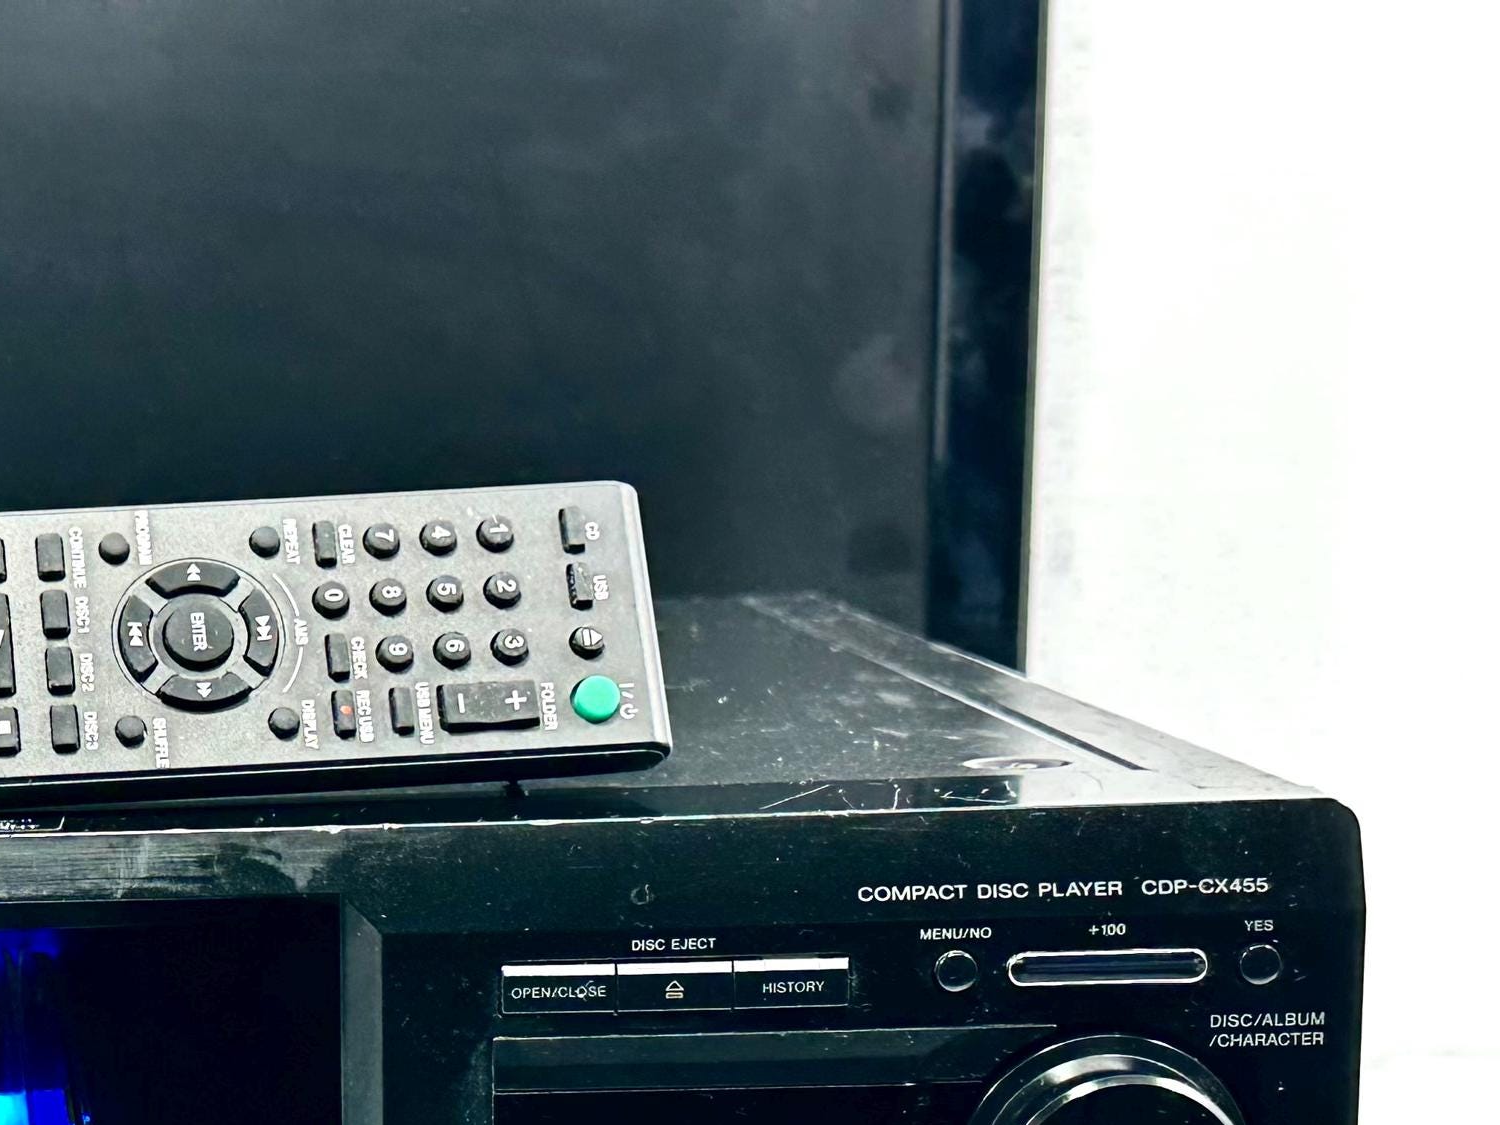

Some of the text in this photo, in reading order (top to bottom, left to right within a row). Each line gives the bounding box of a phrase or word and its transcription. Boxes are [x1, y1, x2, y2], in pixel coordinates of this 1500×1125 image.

[375, 529, 395, 542] 7
[431, 526, 451, 540] 4
[489, 523, 509, 533] 1
[584, 522, 600, 540] CD
[282, 518, 301, 564] REPEAT
[338, 524, 356, 565] CLEAR
[68, 526, 88, 588] CONTINUE
[382, 585, 402, 599] 8
[437, 582, 456, 596] 5
[497, 579, 517, 593] 2
[592, 574, 610, 601] USB
[190, 612, 208, 651] ENTER
[389, 642, 408, 656] 9
[445, 639, 465, 653] 6
[504, 635, 525, 649] 3
[350, 637, 369, 680] CHECK
[540, 682, 559, 730] FOLDER
[301, 699, 319, 749] DISPLAY
[417, 708, 435, 745] MENU
[152, 717, 170, 768] SHUFFLE
[857, 877, 1270, 902] COMPACT DISC PLAYER CDP-CX455
[1087, 922, 1127, 937] +100
[1244, 918, 1274, 933] YES
[919, 926, 993, 942] MENU/NO
[631, 937, 717, 952] DISC EJECT
[510, 983, 607, 999] OPEN/CLOSE
[762, 980, 825, 995] HISTORY
[1209, 1011, 1327, 1030] DISC/ALBUM
[1209, 1031, 1325, 1048] /CHARACTER
